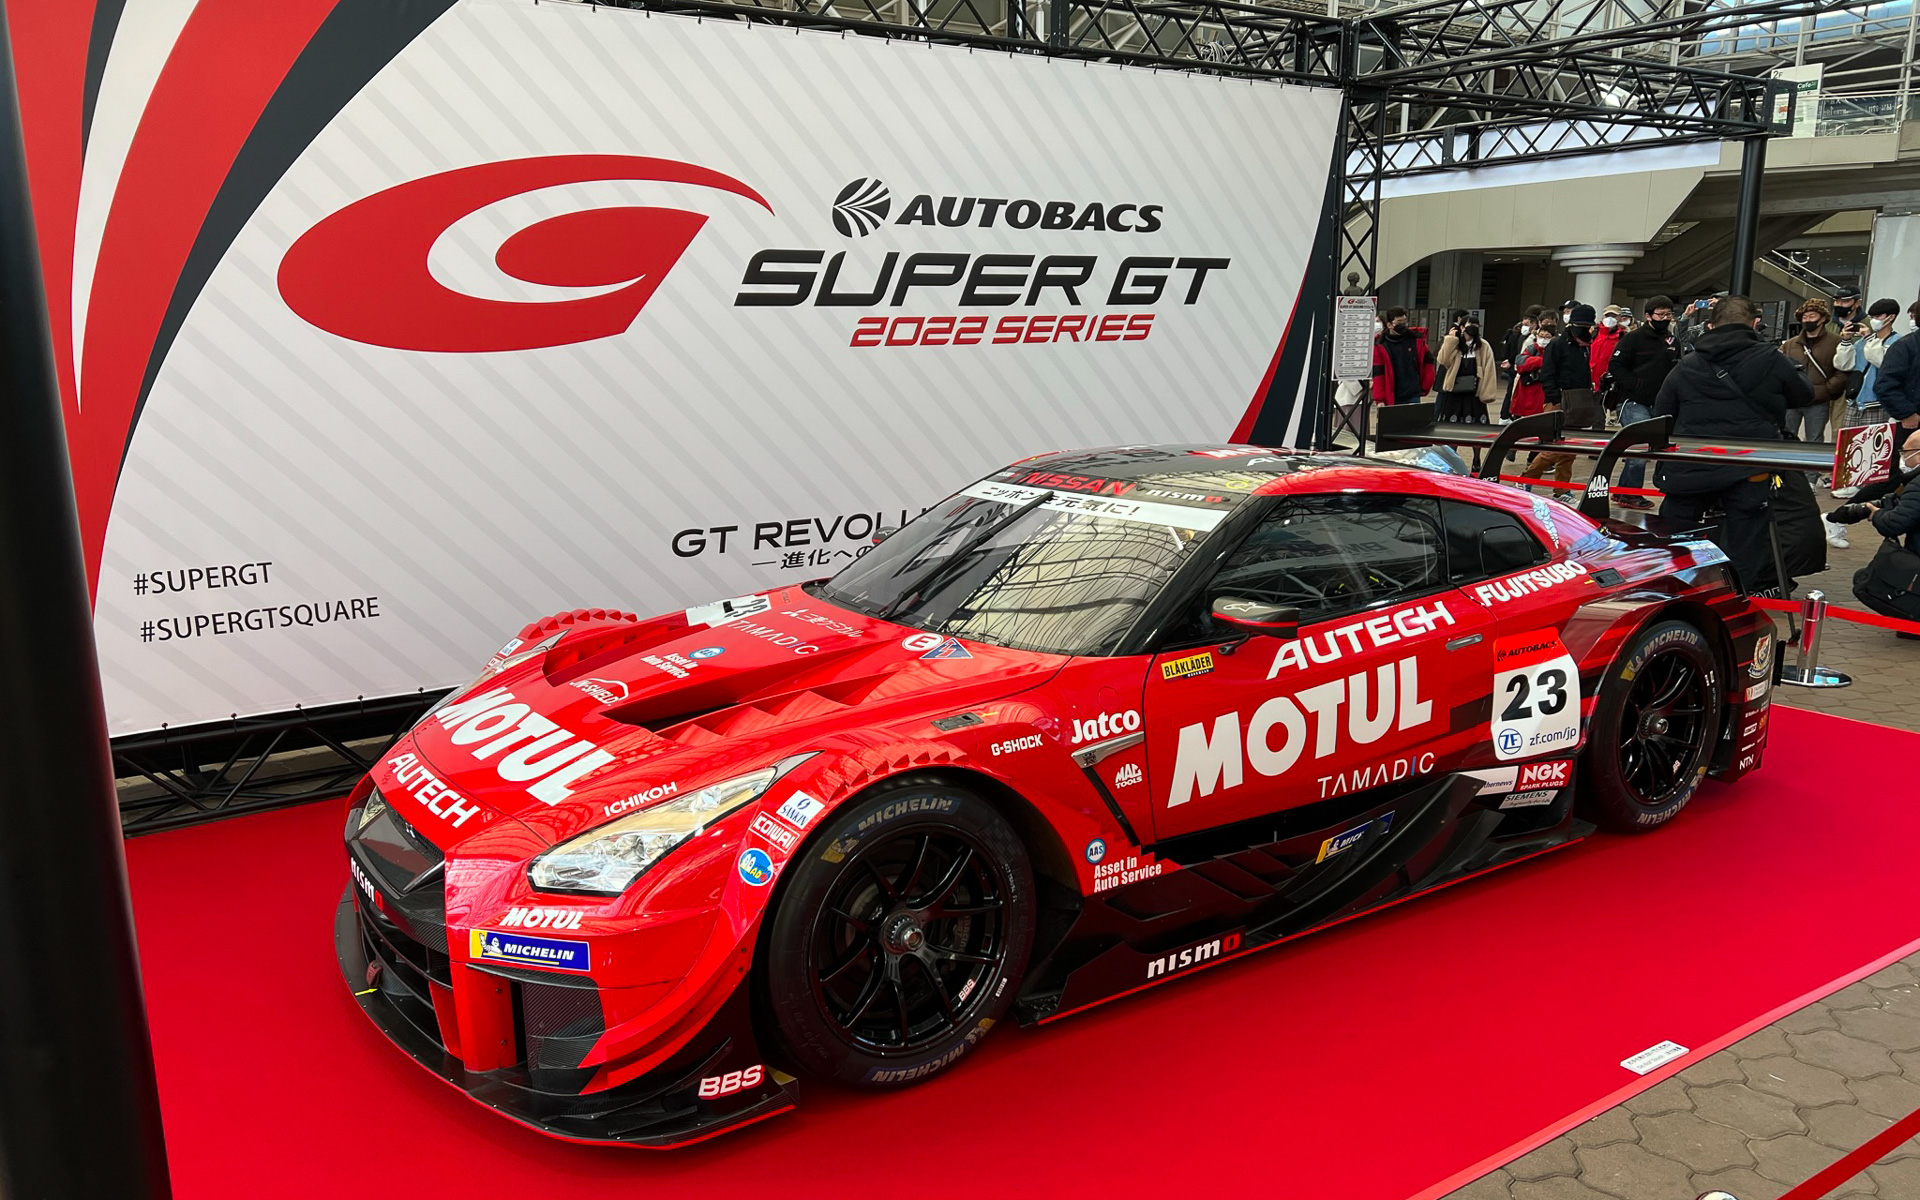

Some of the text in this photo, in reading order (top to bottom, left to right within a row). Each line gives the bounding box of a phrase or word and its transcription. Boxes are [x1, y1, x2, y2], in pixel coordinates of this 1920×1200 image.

[895, 195, 1164, 233] AUTOBACS
[734, 249, 1231, 307] SUPER GT
[849, 314, 1156, 348] 2022 SERIES
[1019, 471, 1138, 496] NISSAN
[1146, 488, 1223, 504] nismo
[1588, 475, 1608, 493] MAC
[1588, 490, 1608, 498] TOOLS
[671, 525, 739, 558] GT
[134, 562, 273, 596] #SUPERGT
[1475, 559, 1588, 608] FUJITSUBO
[140, 597, 381, 643] #SUPERGTSQUARE
[727, 619, 819, 655] TAMADIC
[1266, 600, 1456, 681] AUTECH
[1507, 640, 1557, 658] AUTOBACS
[1643, 629, 1698, 658] MICHELIN
[656, 661, 690, 679] Service
[1164, 655, 1212, 677] BLÅKLÄDER
[1501, 668, 1568, 722] 23
[1071, 709, 1141, 744] Jatco
[1167, 655, 1433, 809] MOTUL
[1503, 733, 1518, 750] ZF
[1529, 727, 1577, 746] zf.com/jp
[435, 686, 616, 807] MOTUL
[991, 734, 1043, 757] G-SHOCK
[1115, 763, 1142, 785] MAC
[1317, 752, 1436, 799] TAMADIC
[1522, 762, 1568, 784] NGK
[1739, 754, 1755, 770] NTN
[388, 752, 481, 828] AUTECH
[1115, 775, 1143, 789] TOOLS
[1505, 790, 1548, 802] SIEMENS
[1520, 780, 1564, 791] SPARK PLUGS
[604, 781, 678, 818] ICHIKOH
[858, 798, 953, 831] MICHELIN
[1636, 790, 1692, 825] MICHELIN
[1088, 846, 1104, 857] AAS
[1094, 856, 1138, 879] Asset in
[350, 856, 384, 912] nismo
[1094, 862, 1162, 893] Auto Service
[499, 907, 584, 929] MOTUL
[503, 942, 575, 961] MICHELIN
[1147, 933, 1241, 979] nismo
[871, 1043, 965, 1082] MICHELIN
[698, 1065, 765, 1099] BBS
